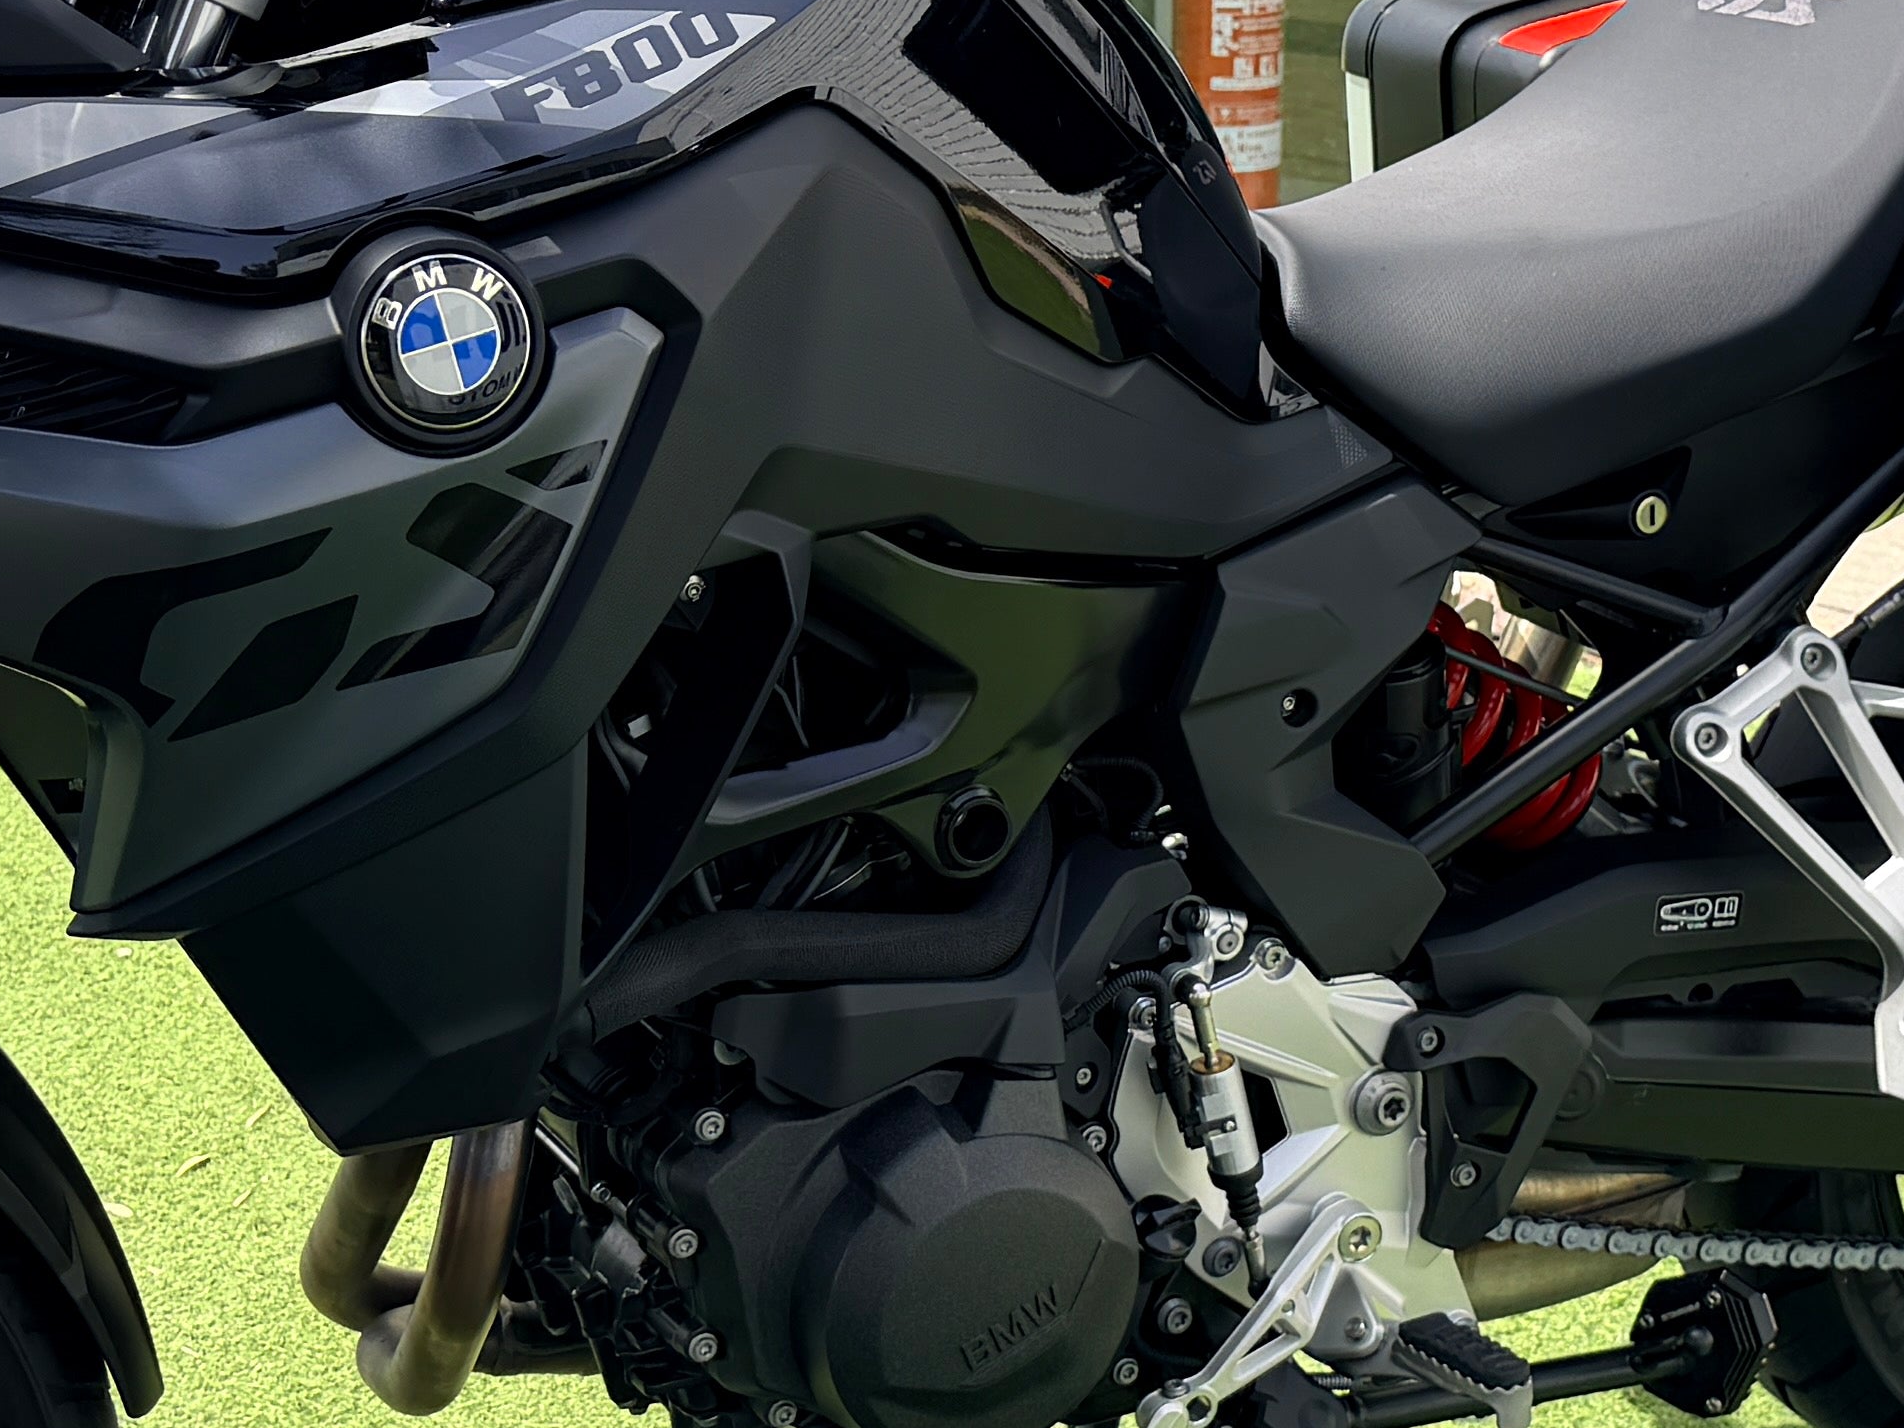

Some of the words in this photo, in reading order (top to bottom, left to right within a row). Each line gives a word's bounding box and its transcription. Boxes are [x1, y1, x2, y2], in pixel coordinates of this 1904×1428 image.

[490, 6, 741, 124] F800
[371, 259, 505, 332] BMW
[959, 1283, 1059, 1372] BMW
